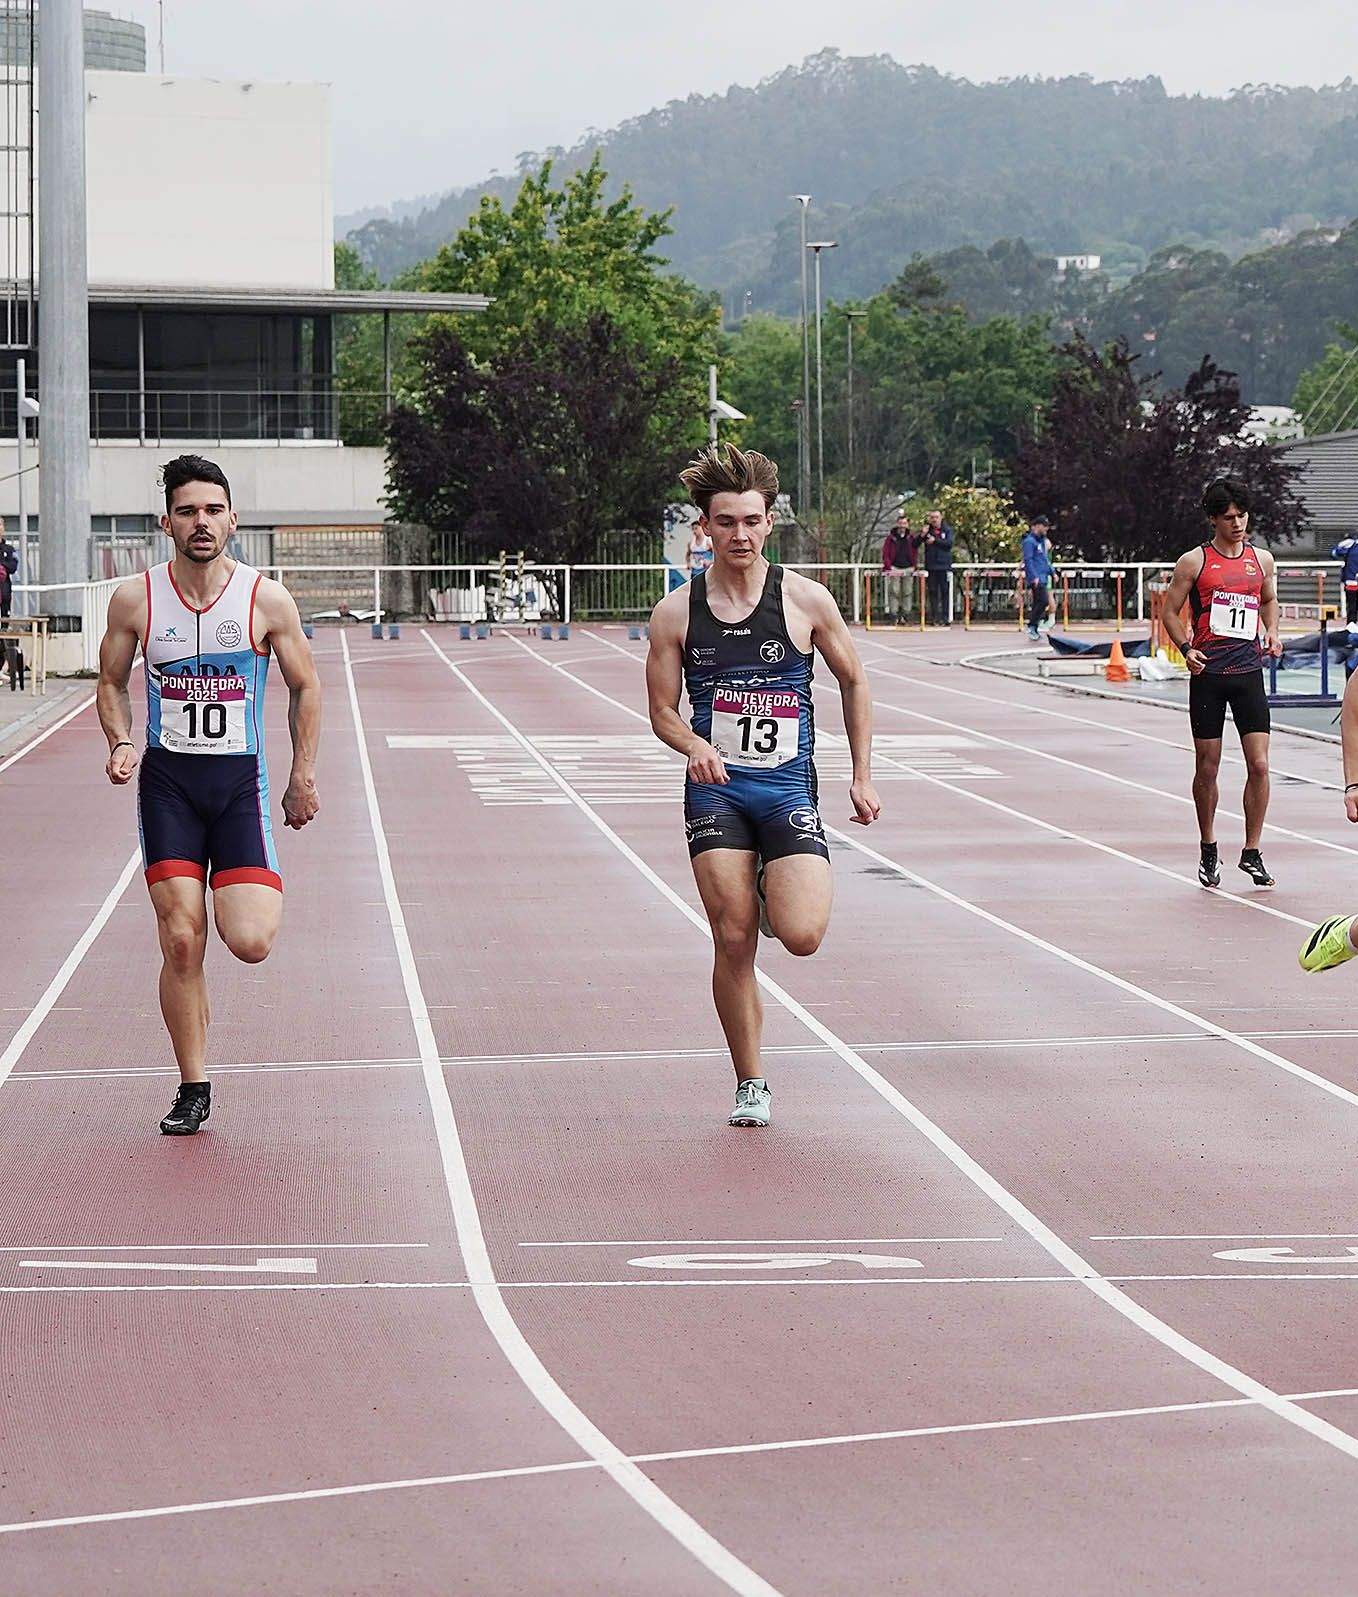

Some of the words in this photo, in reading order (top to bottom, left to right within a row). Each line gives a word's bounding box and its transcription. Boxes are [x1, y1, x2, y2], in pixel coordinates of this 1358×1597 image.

[1229, 607, 1246, 629] 11
[162, 675, 245, 691] PONTEVEDRA
[186, 690, 218, 701] 2025
[716, 688, 800, 708] PONTEVEDRA
[741, 704, 773, 716] 2025
[182, 702, 227, 739] 10
[736, 716, 779, 754] 13
